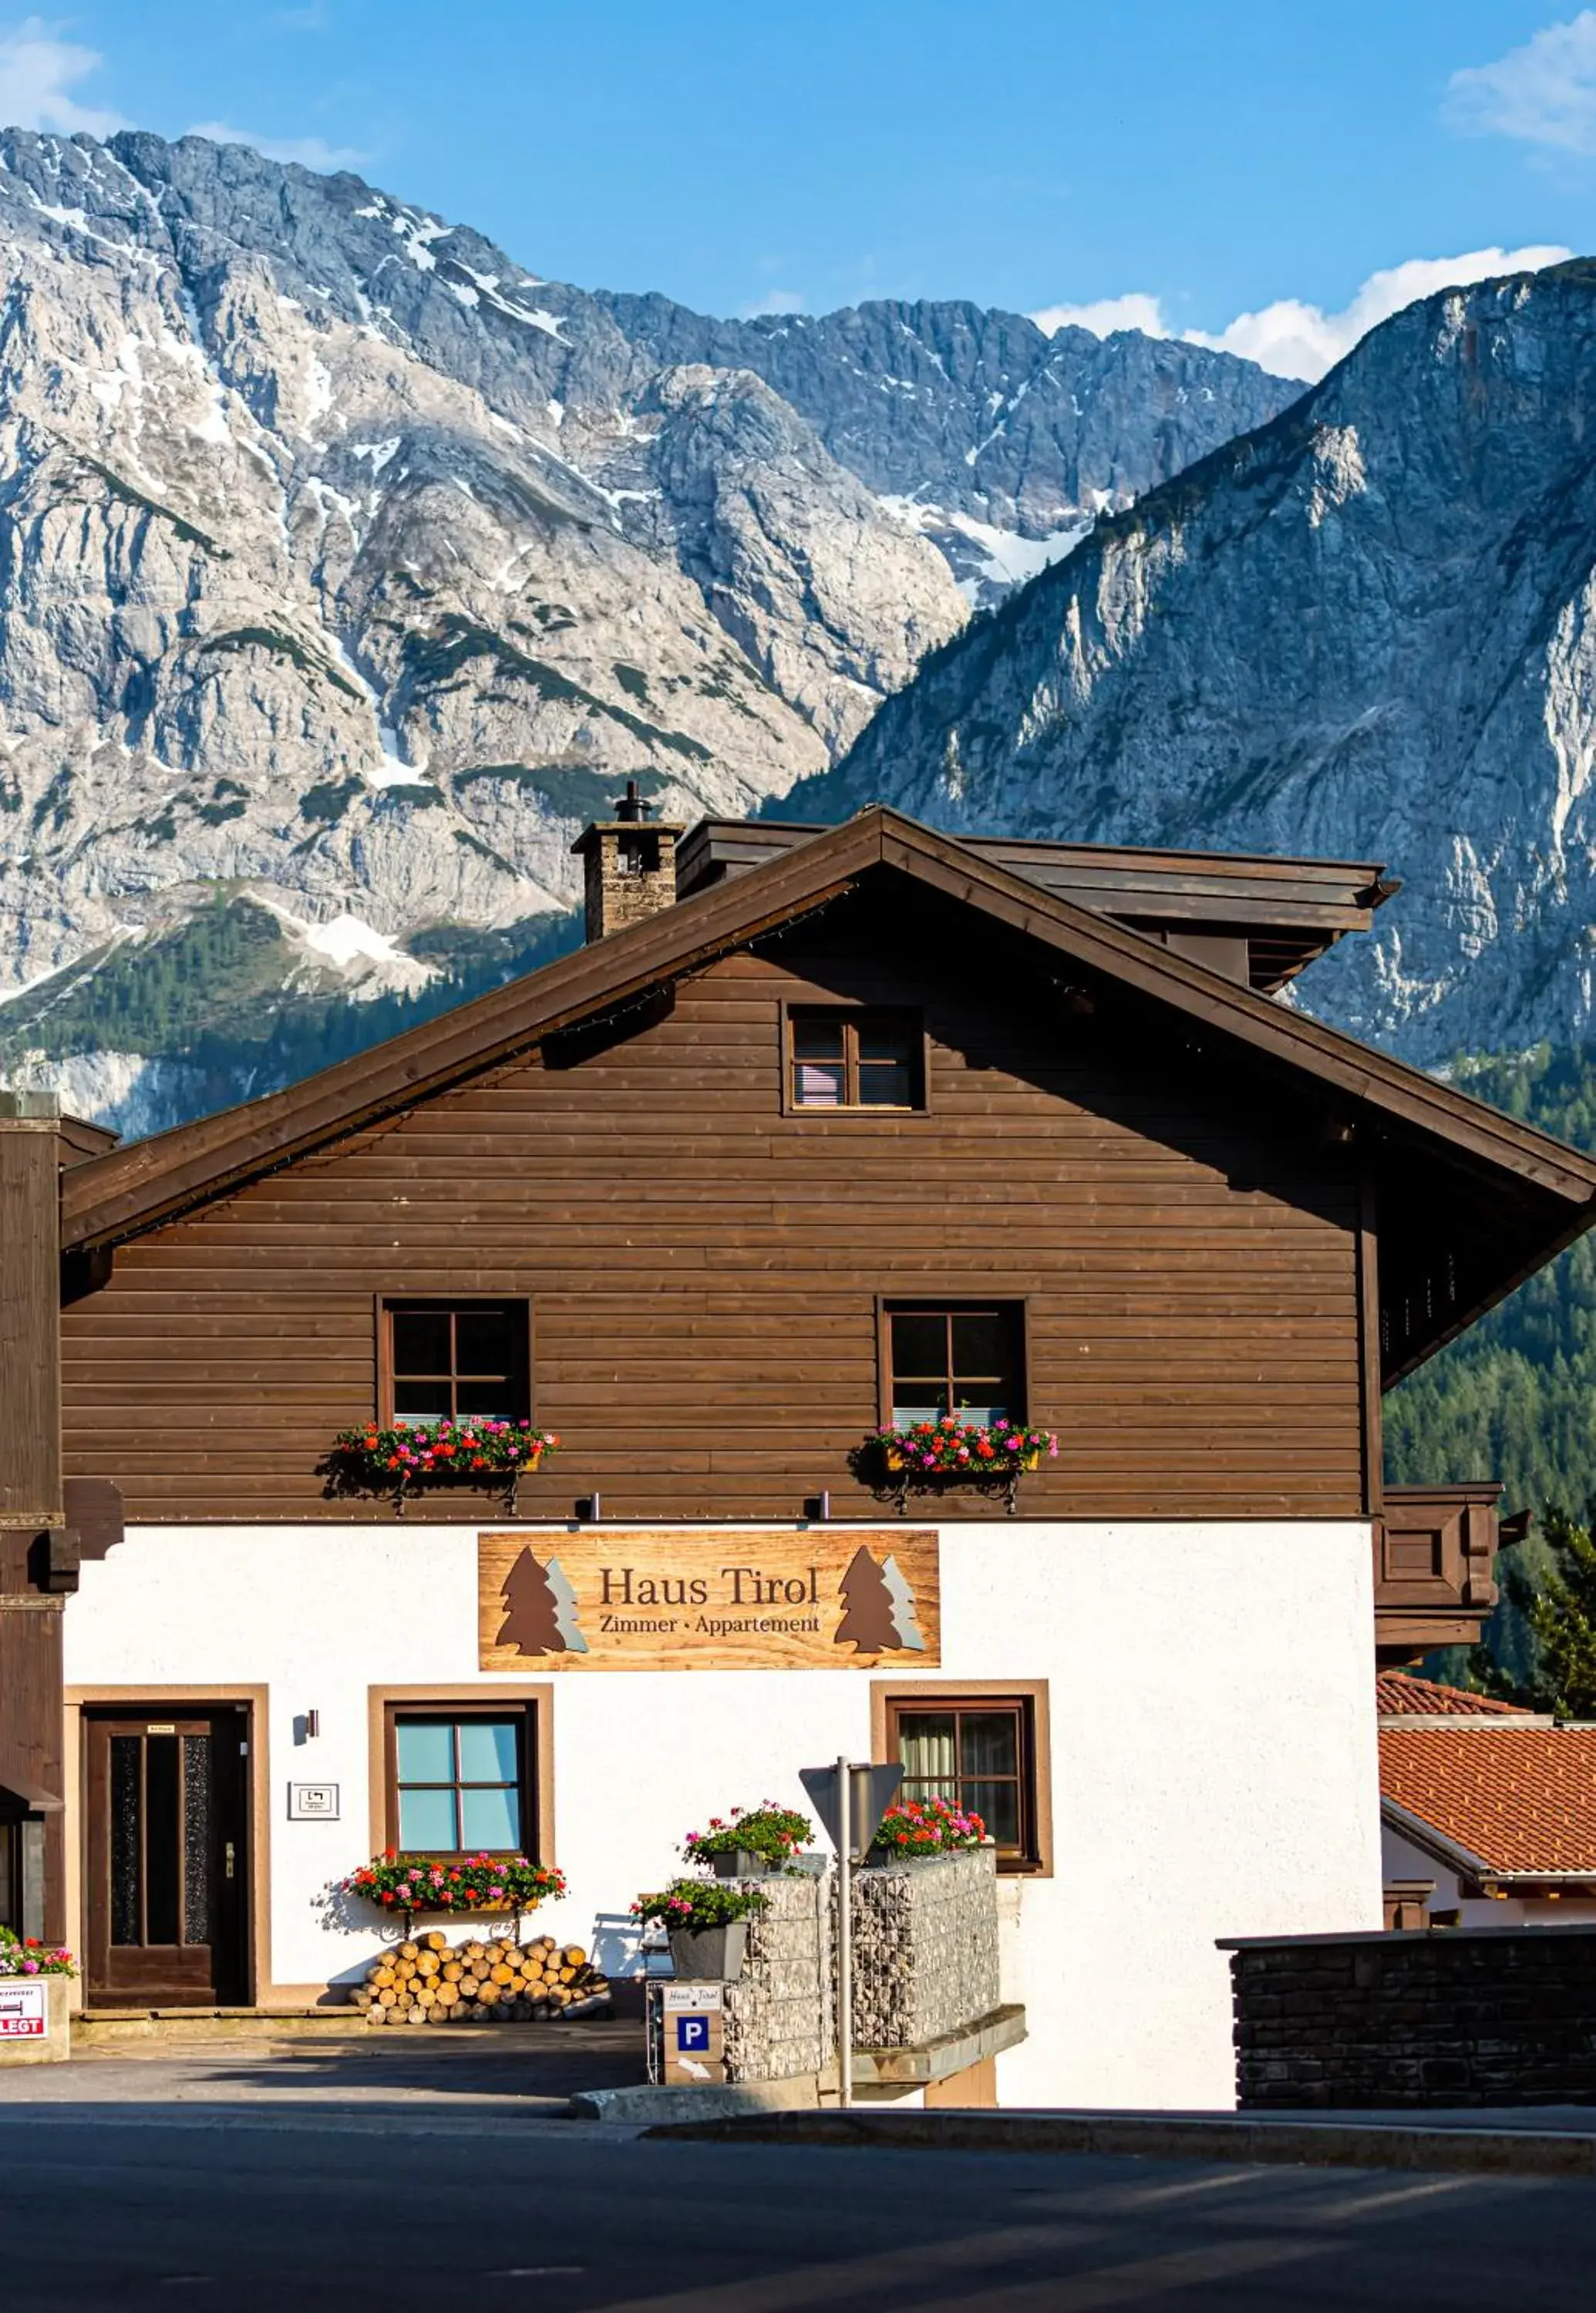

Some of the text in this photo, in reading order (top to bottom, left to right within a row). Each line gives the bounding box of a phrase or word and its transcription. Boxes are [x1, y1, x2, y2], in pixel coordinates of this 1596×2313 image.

[599, 1567, 820, 1605] Haus Tirol
[599, 1614, 820, 1637] Zimmer Appartement
[685, 2022, 702, 2045] P
